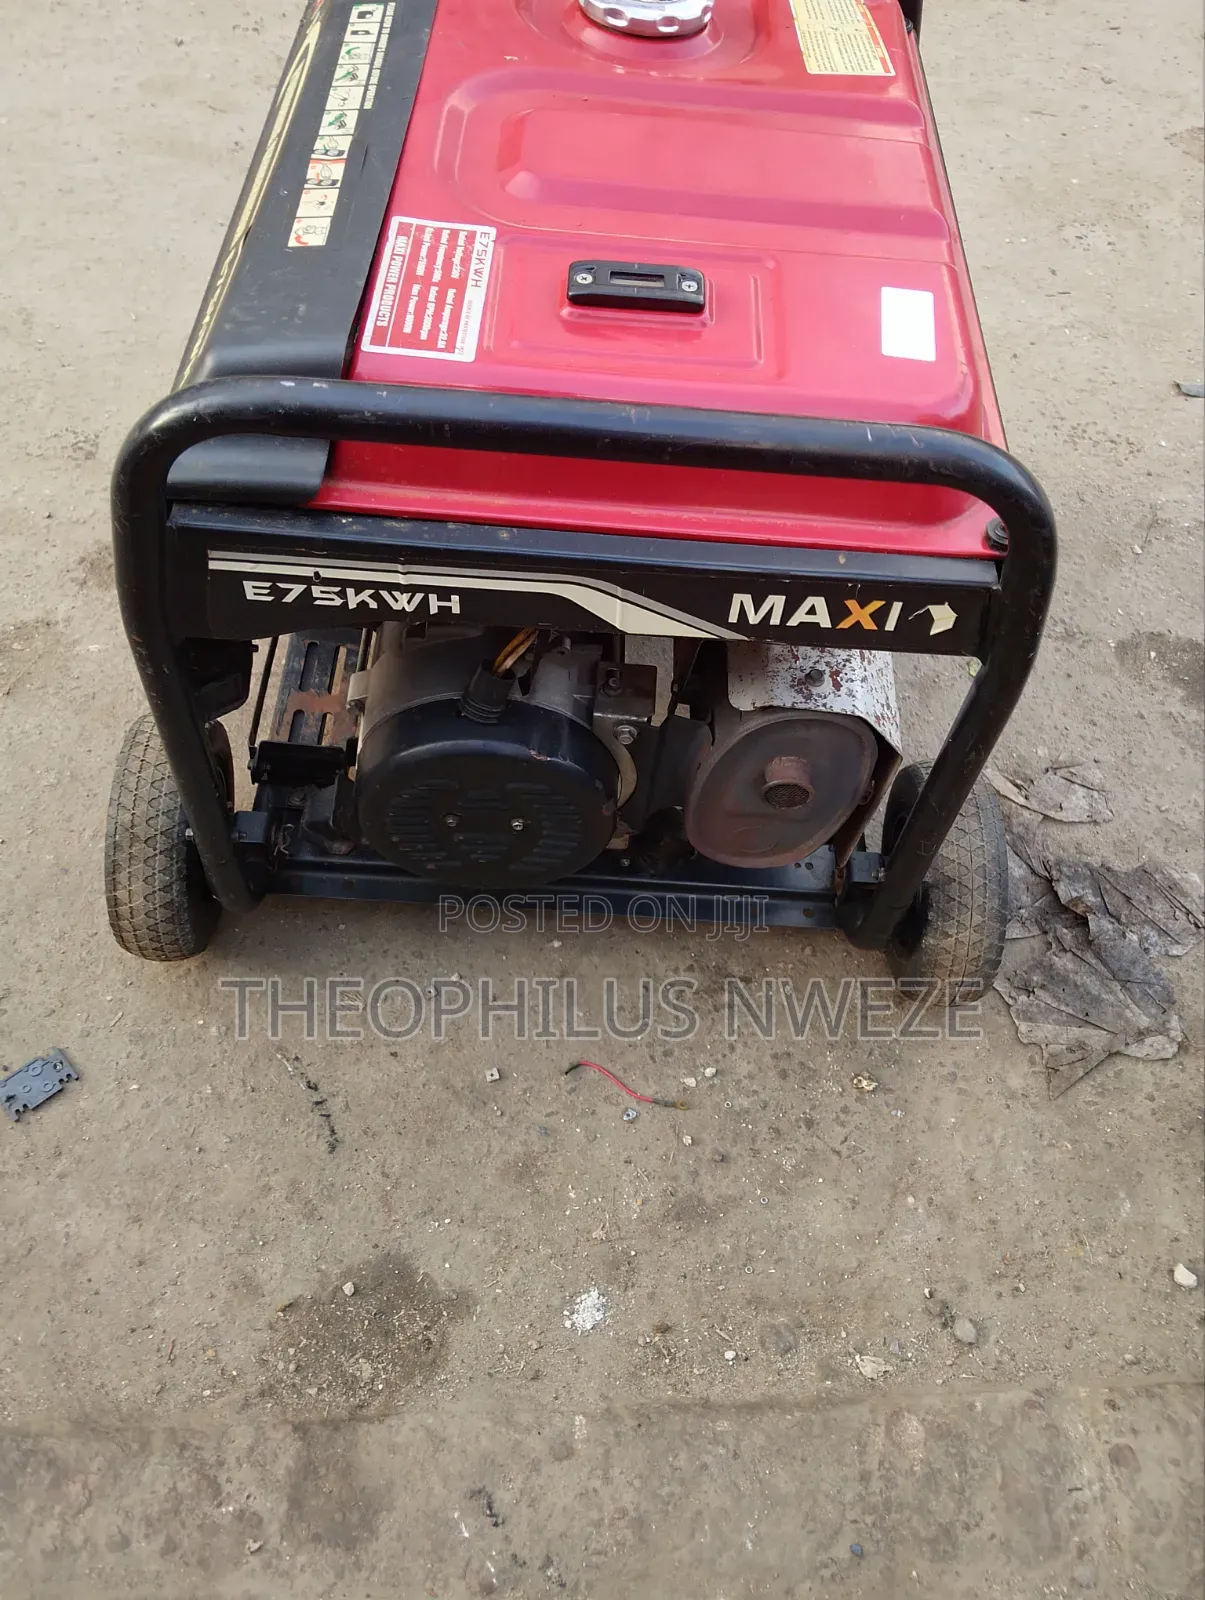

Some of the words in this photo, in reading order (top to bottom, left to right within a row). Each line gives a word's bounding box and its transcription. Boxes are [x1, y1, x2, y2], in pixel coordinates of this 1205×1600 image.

[423, 227, 433, 241] Rated
[440, 229, 450, 243] Rated
[457, 231, 467, 245] Rated
[394, 235, 407, 254] MAXI
[470, 231, 490, 289] E75KWH
[387, 255, 403, 283] POWER
[411, 284, 421, 295] Max
[427, 286, 438, 301] Rated
[445, 288, 456, 303] Rated
[377, 284, 395, 326] PRODUCTS
[242, 580, 461, 615] E75KWH
[727, 593, 903, 632] MAXI
